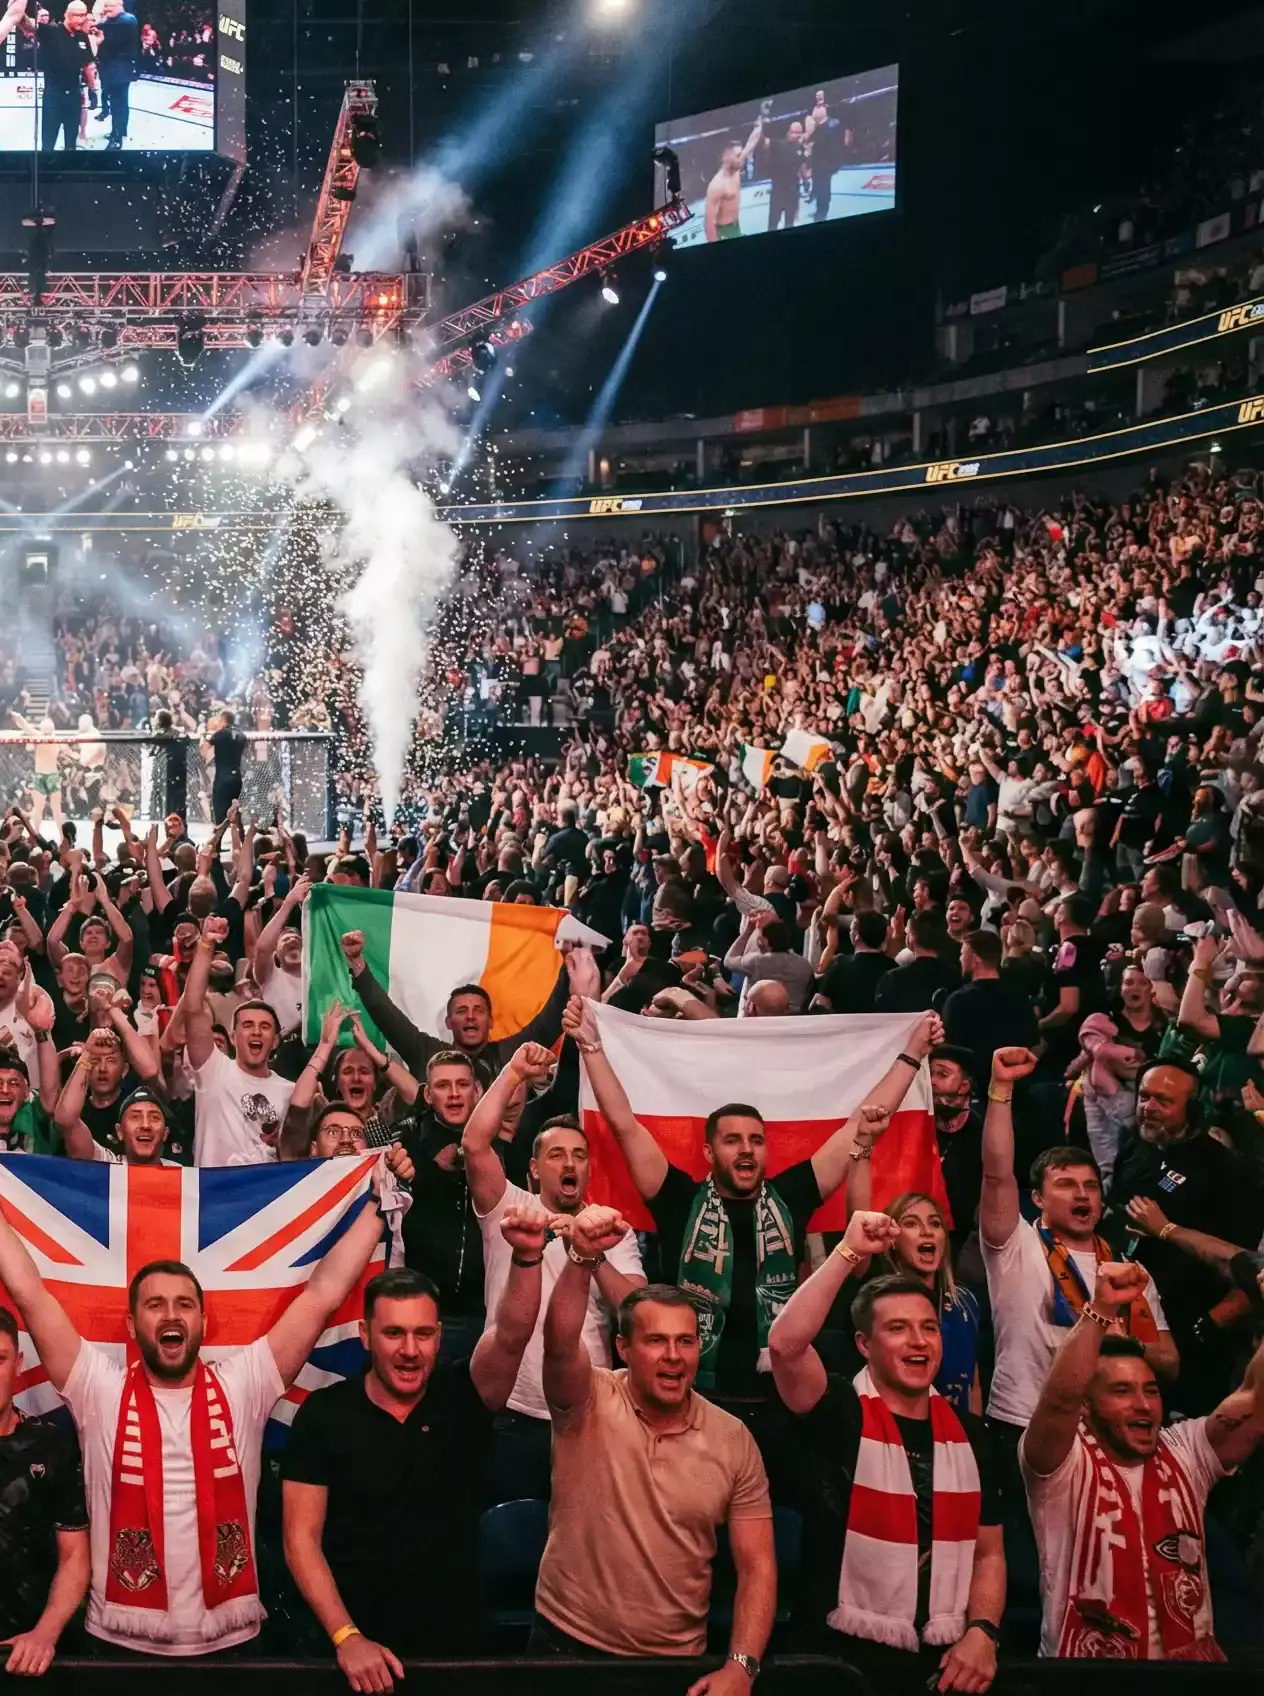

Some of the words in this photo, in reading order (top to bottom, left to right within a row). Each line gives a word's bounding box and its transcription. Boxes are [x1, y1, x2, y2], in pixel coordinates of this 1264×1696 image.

[219, 14, 245, 41] UFC
[1218, 305, 1253, 331] UFC
[1238, 399, 1264, 423] UF
[926, 462, 960, 482] UFC
[589, 499, 623, 513] UFC
